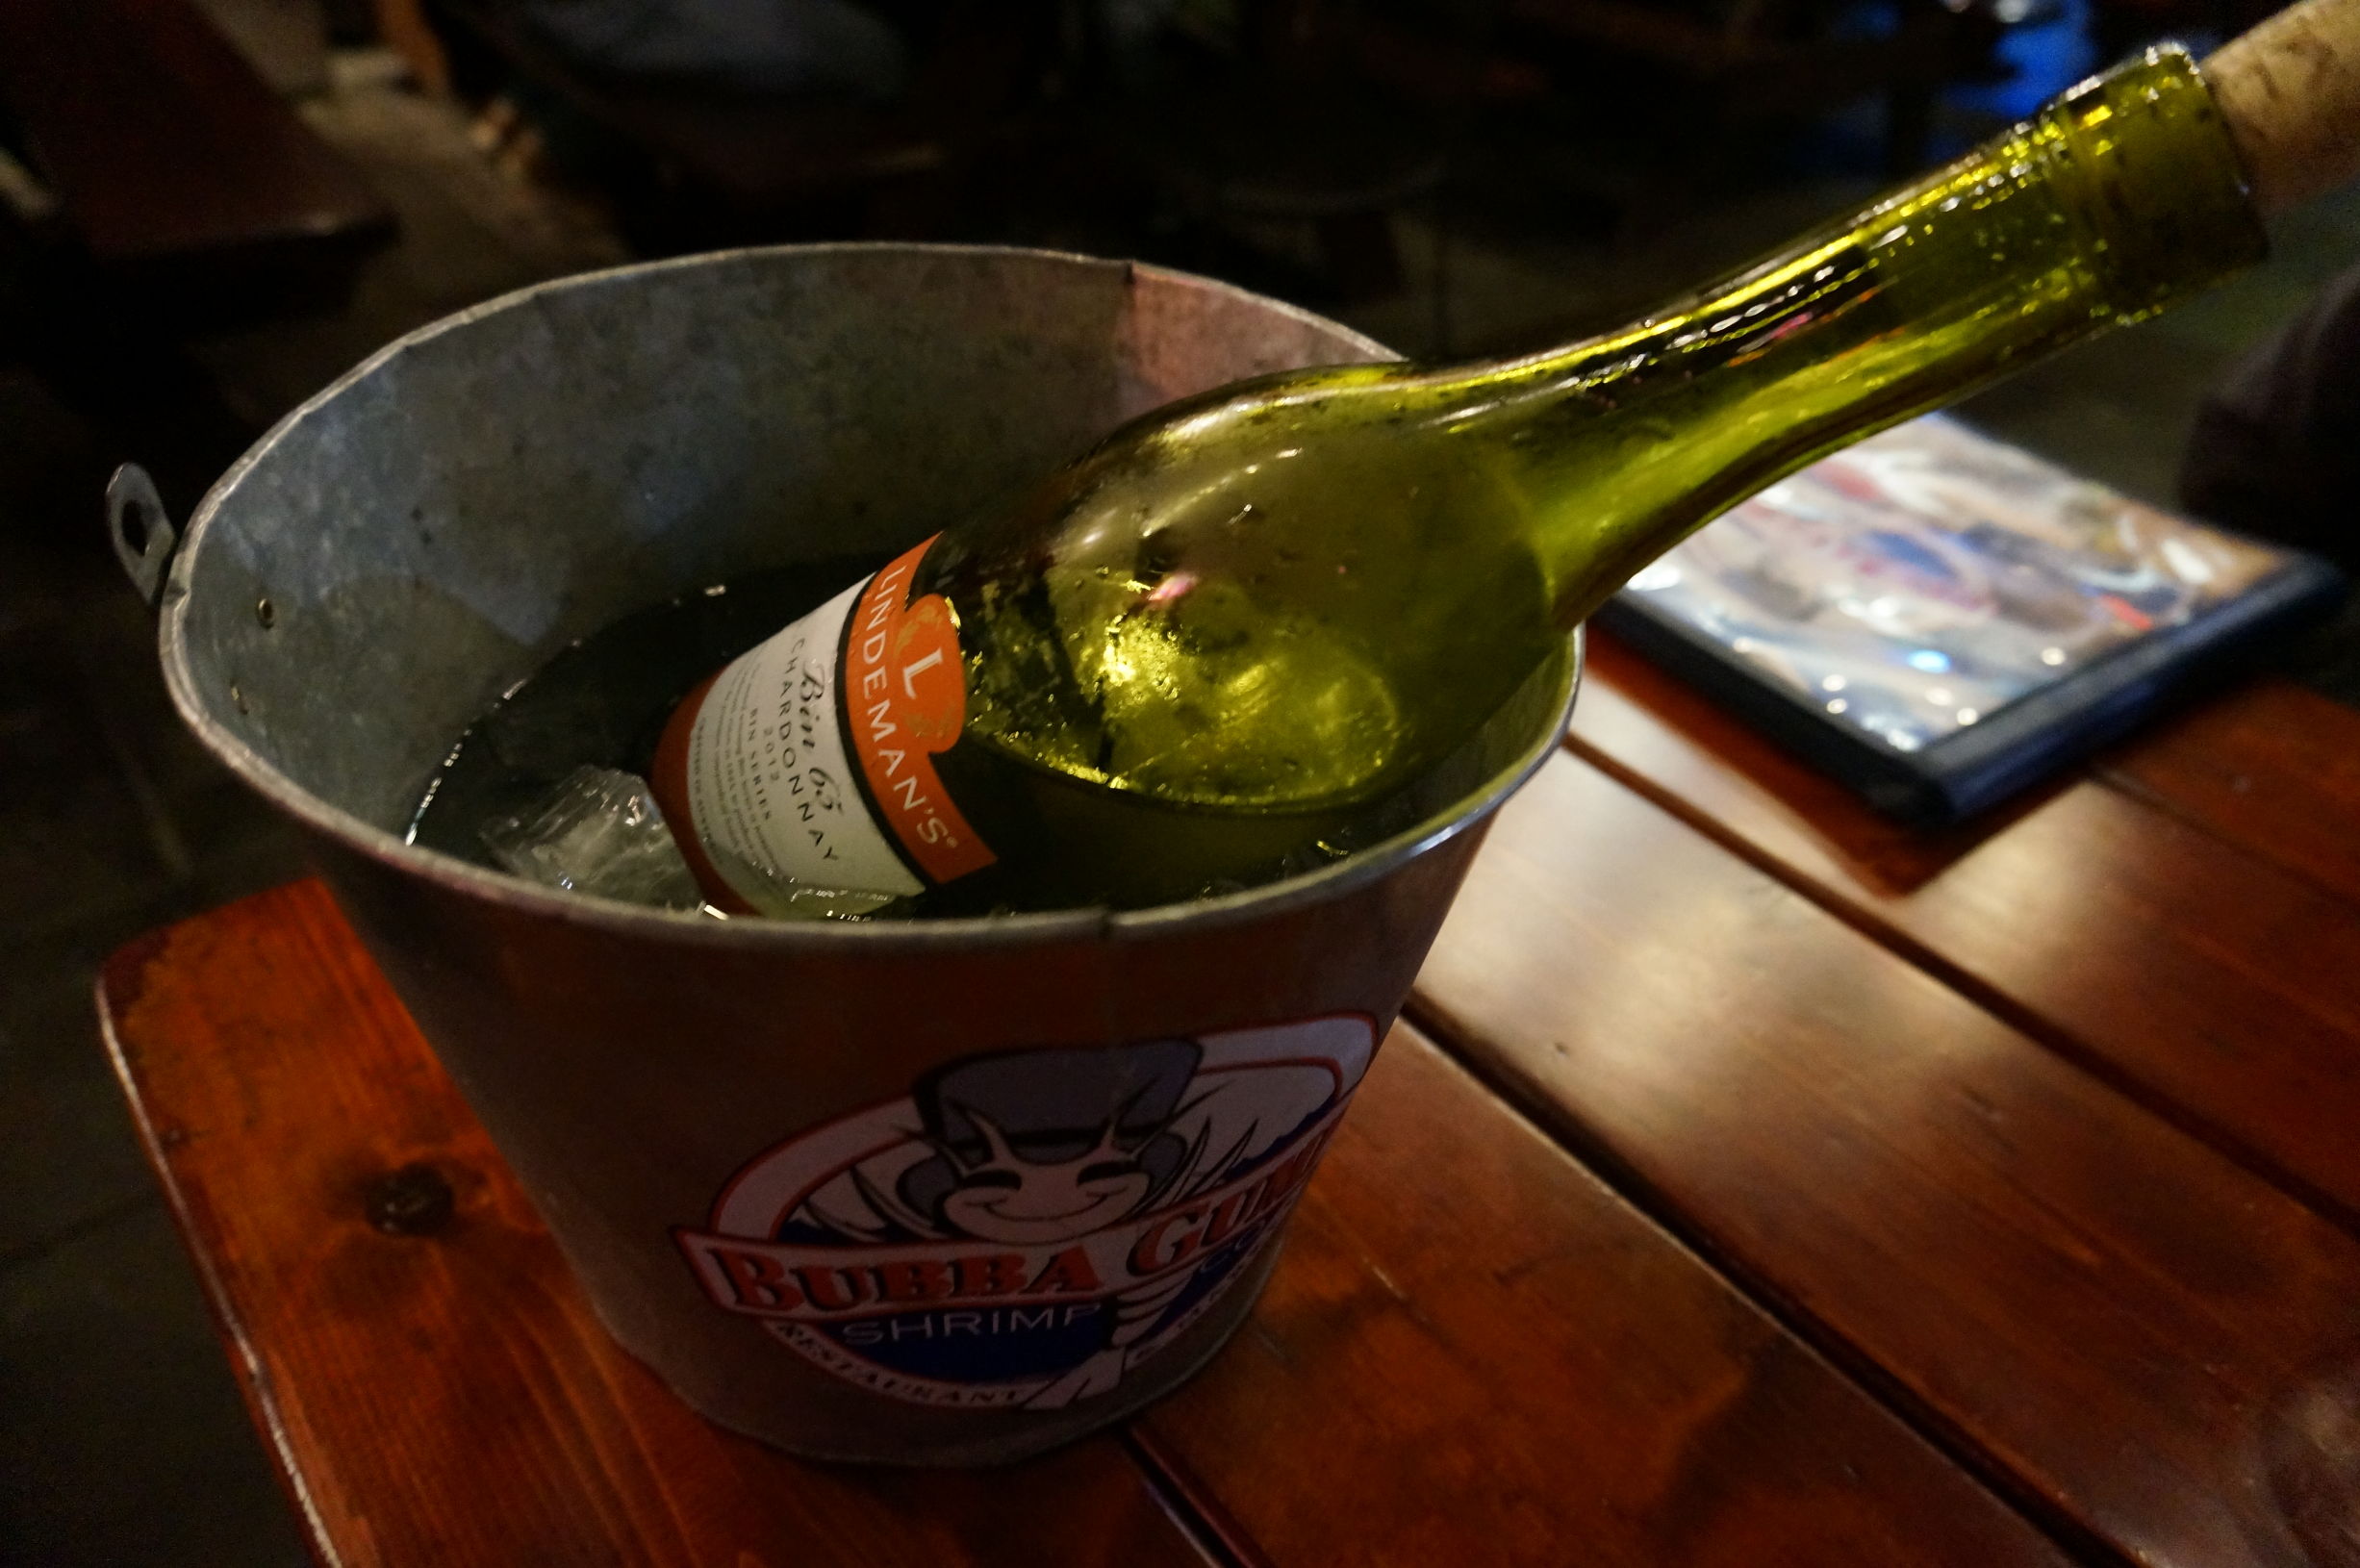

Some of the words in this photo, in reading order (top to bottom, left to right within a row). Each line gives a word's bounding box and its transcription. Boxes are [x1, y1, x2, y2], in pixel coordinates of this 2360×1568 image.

[799, 659, 825, 749] Bin
[863, 566, 949, 846] LINDEMAN'S
[902, 646, 944, 700] L
[778, 638, 839, 862] CHARDONNAY
[809, 767, 843, 815] 65
[713, 1245, 1104, 1311] BUBBA
[1126, 1124, 1341, 1276] GUM
[843, 1302, 1103, 1345] SHRIMP
